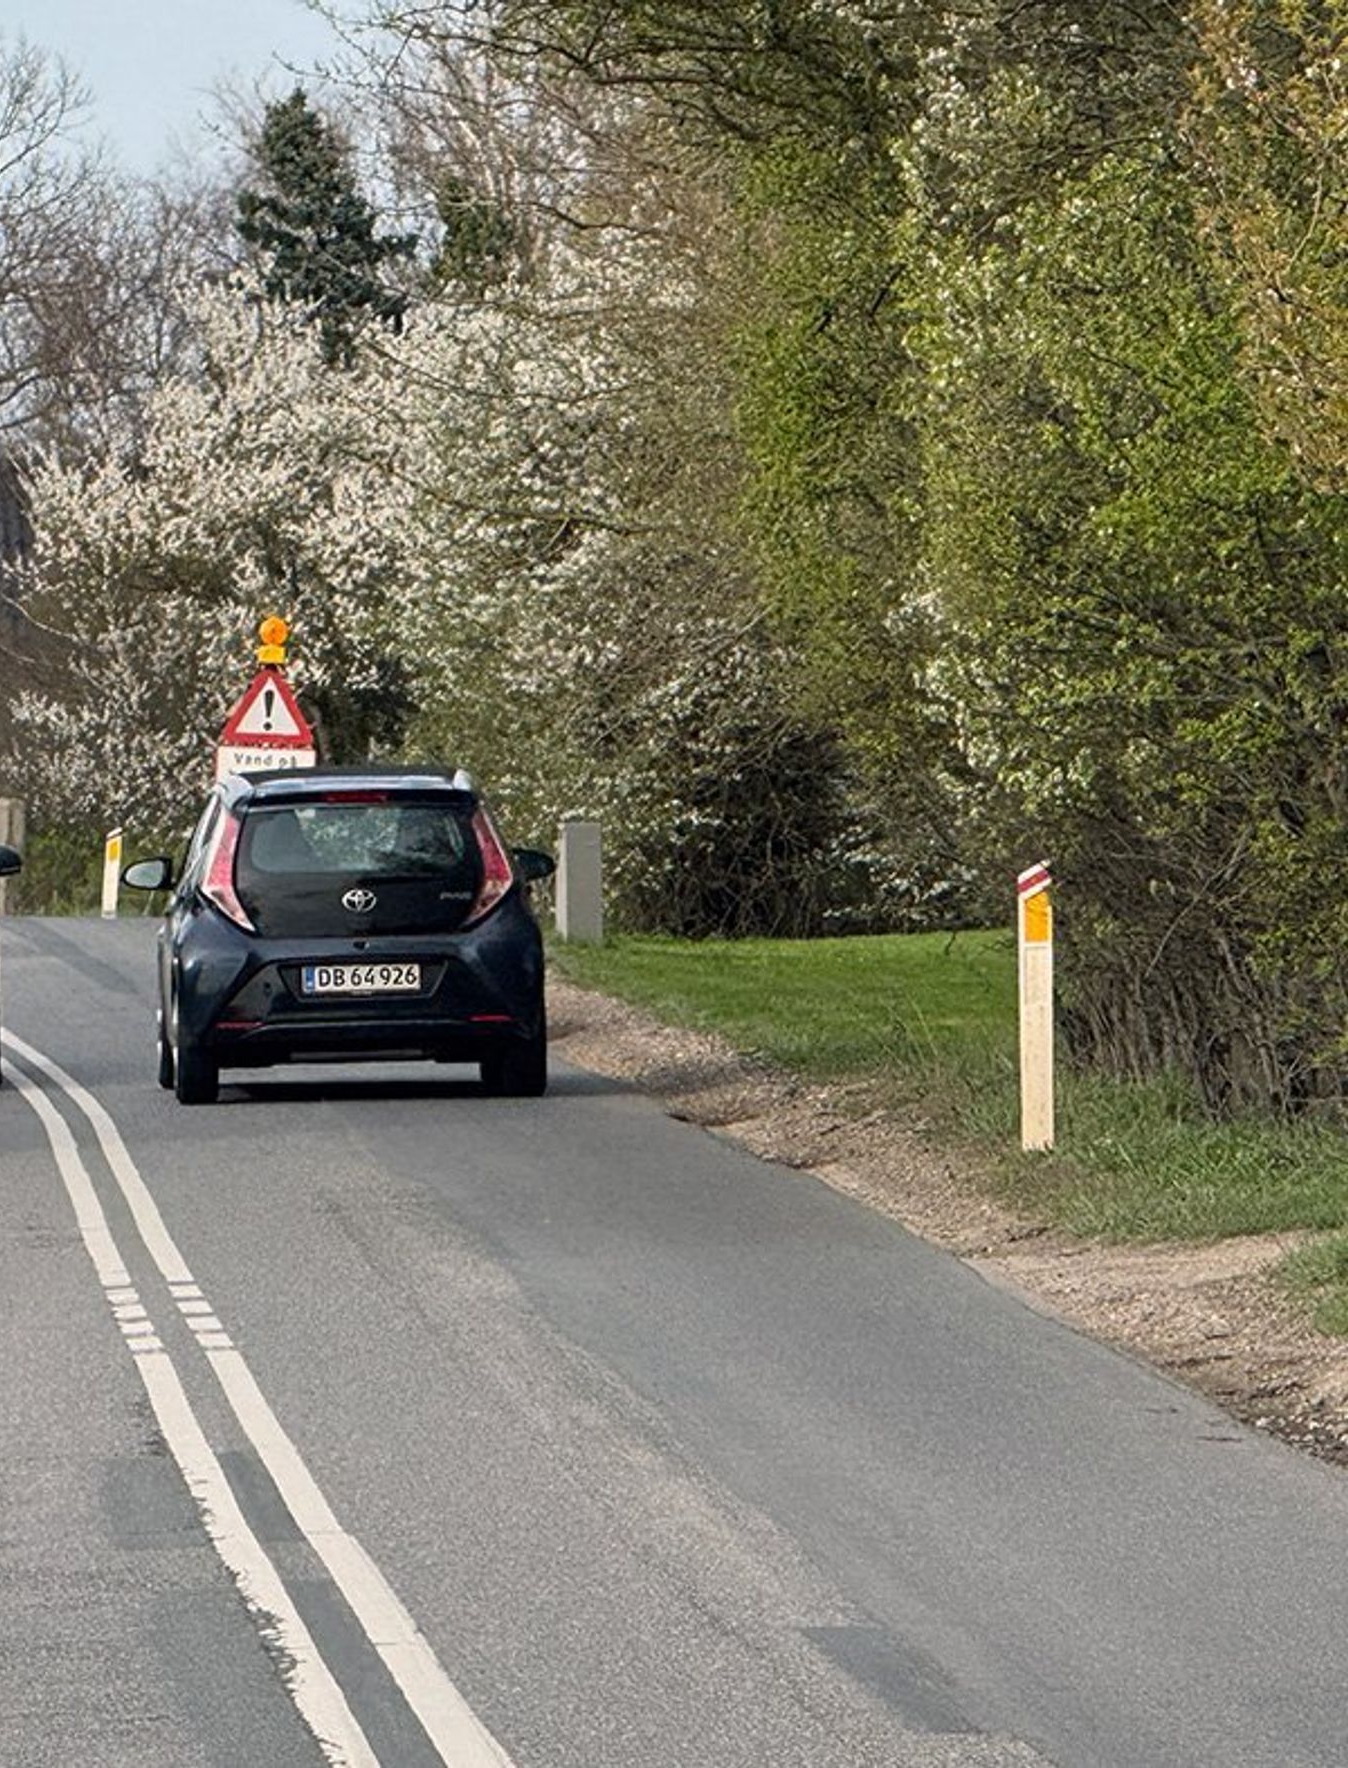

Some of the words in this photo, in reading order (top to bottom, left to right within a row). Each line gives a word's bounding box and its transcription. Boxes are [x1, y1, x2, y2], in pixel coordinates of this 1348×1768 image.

[234, 752, 273, 767] Vand
[318, 968, 346, 987] DB
[351, 967, 374, 986] 64
[379, 965, 418, 985] 926
